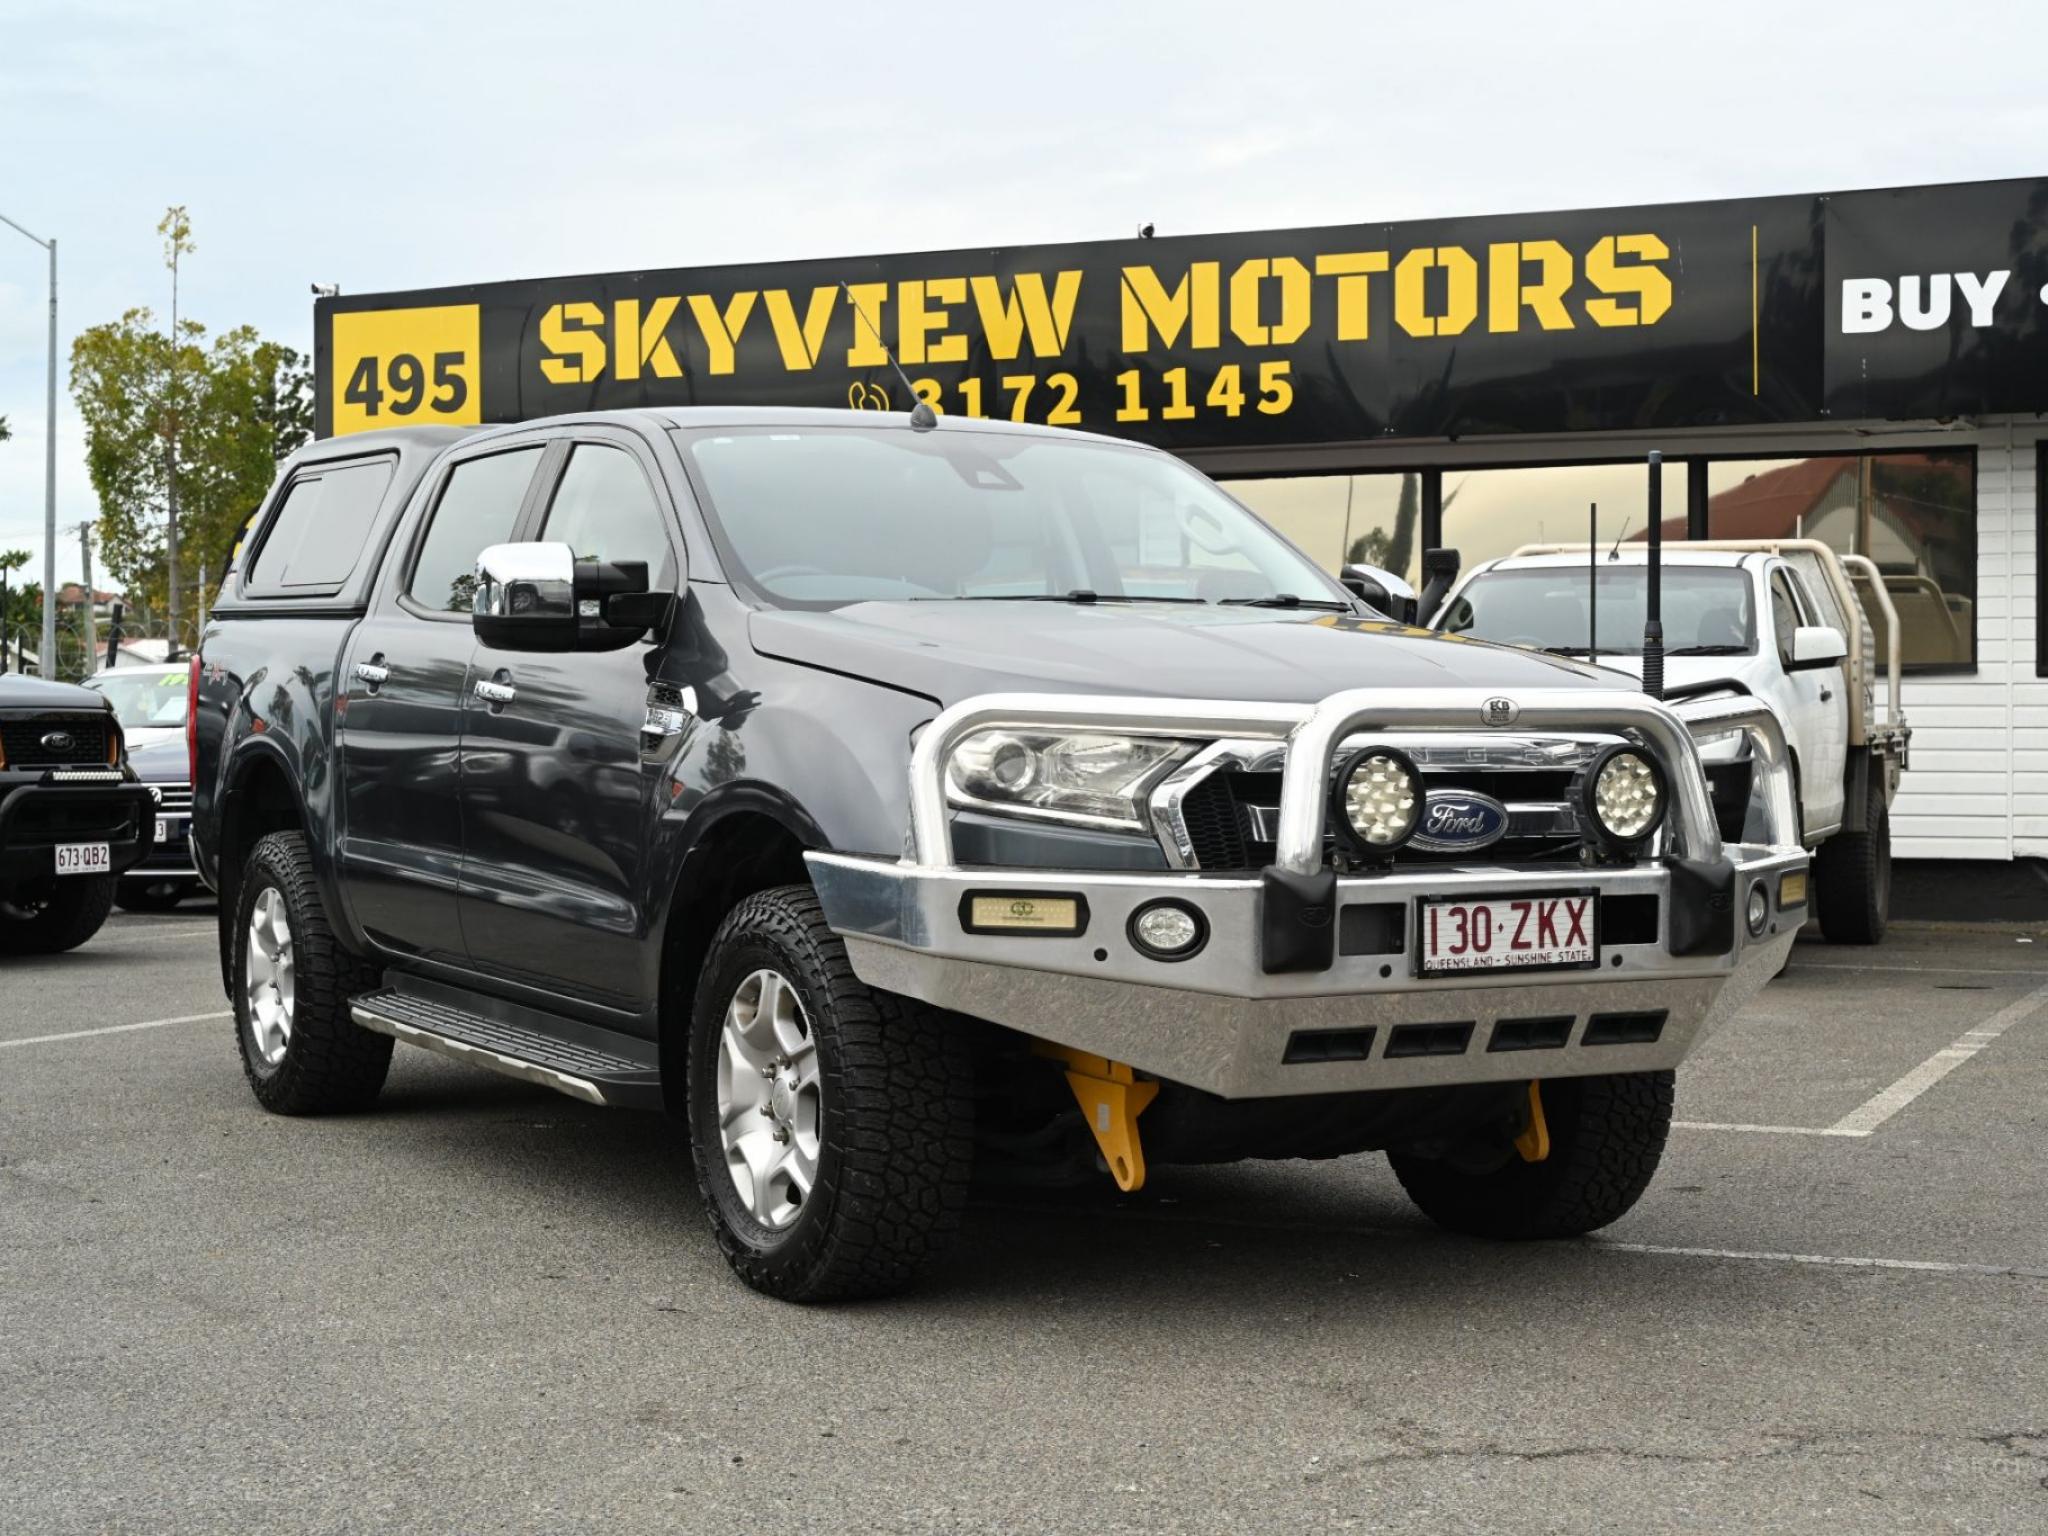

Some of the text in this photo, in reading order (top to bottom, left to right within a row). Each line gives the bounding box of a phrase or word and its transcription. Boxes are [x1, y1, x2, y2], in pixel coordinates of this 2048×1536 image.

[540, 233, 1672, 384] SKYVIEW MOTORS
[1841, 270, 2011, 334] BUY
[344, 351, 467, 416] 495
[911, 360, 1293, 427] 3172 1145
[1426, 804, 1484, 834] Ford
[1505, 951, 1553, 966] SUNSHINE
